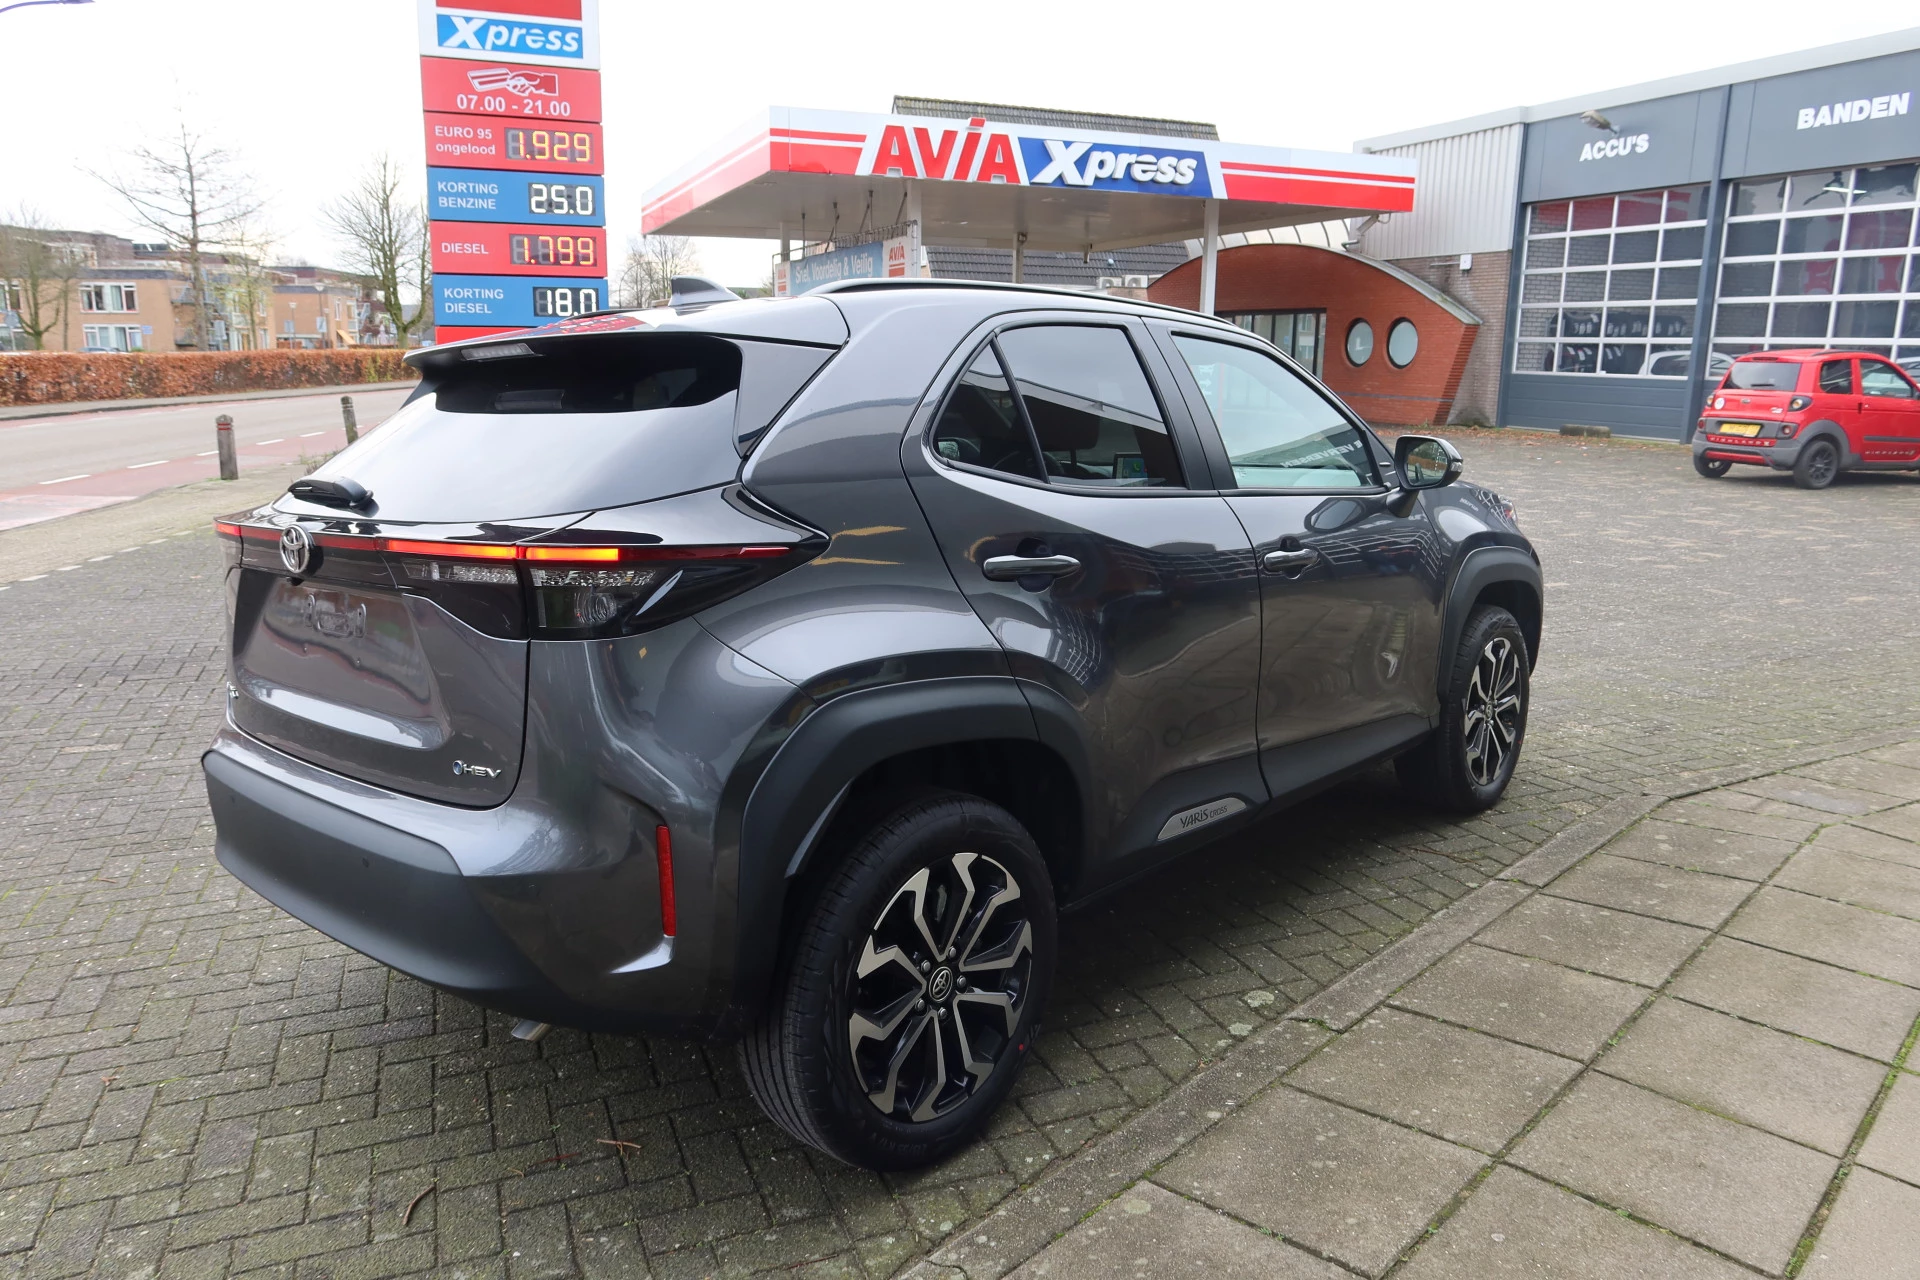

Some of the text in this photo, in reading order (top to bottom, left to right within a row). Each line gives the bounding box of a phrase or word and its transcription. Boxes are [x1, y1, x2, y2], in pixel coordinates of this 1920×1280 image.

[442, 16, 579, 52] Xpress
[456, 94, 506, 113] 07.00
[523, 99, 571, 117] 21.00
[1796, 92, 1911, 131] BANDEN
[435, 125, 492, 140] EURO 95
[435, 142, 496, 156] ongelood
[517, 130, 591, 162] 1.929
[871, 117, 1021, 184] AVIA
[1579, 133, 1650, 162] ACCU'S
[1029, 138, 1198, 187] Xpress
[437, 181, 499, 195] KORTING
[530, 183, 593, 216] 25.0
[438, 196, 497, 210] BENZINE
[440, 242, 489, 255] DIESEL
[522, 235, 594, 265] 1.799
[851, 252, 873, 278] Veilig
[443, 287, 504, 300] KORTING
[546, 288, 597, 317] 18.0
[444, 303, 493, 314] DIESEL
[463, 764, 502, 778] HEV
[1210, 805, 1228, 818] CROSS
